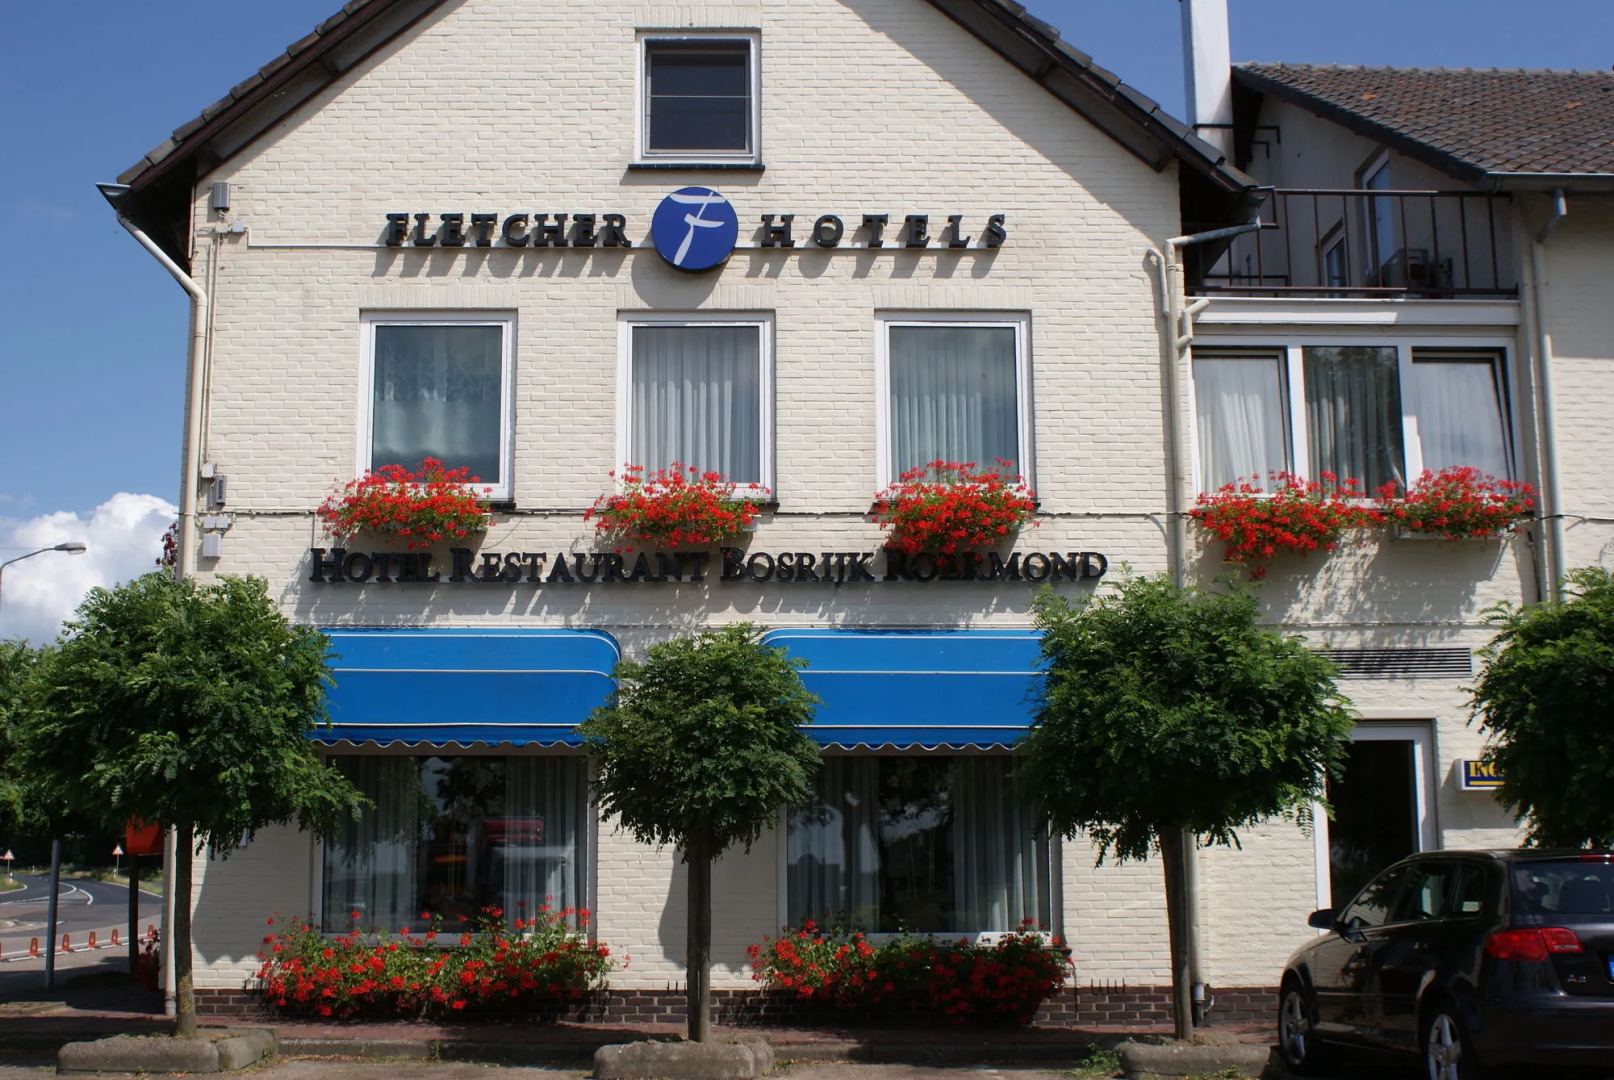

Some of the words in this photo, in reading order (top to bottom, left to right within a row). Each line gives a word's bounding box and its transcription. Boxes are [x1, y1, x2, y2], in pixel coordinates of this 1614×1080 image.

[385, 213, 632, 248] FLETCHER
[760, 213, 1007, 248] HOTELS
[308, 547, 441, 583] HOTEL
[449, 547, 710, 583] RESTAURANT
[719, 547, 876, 588] BOSRIJK
